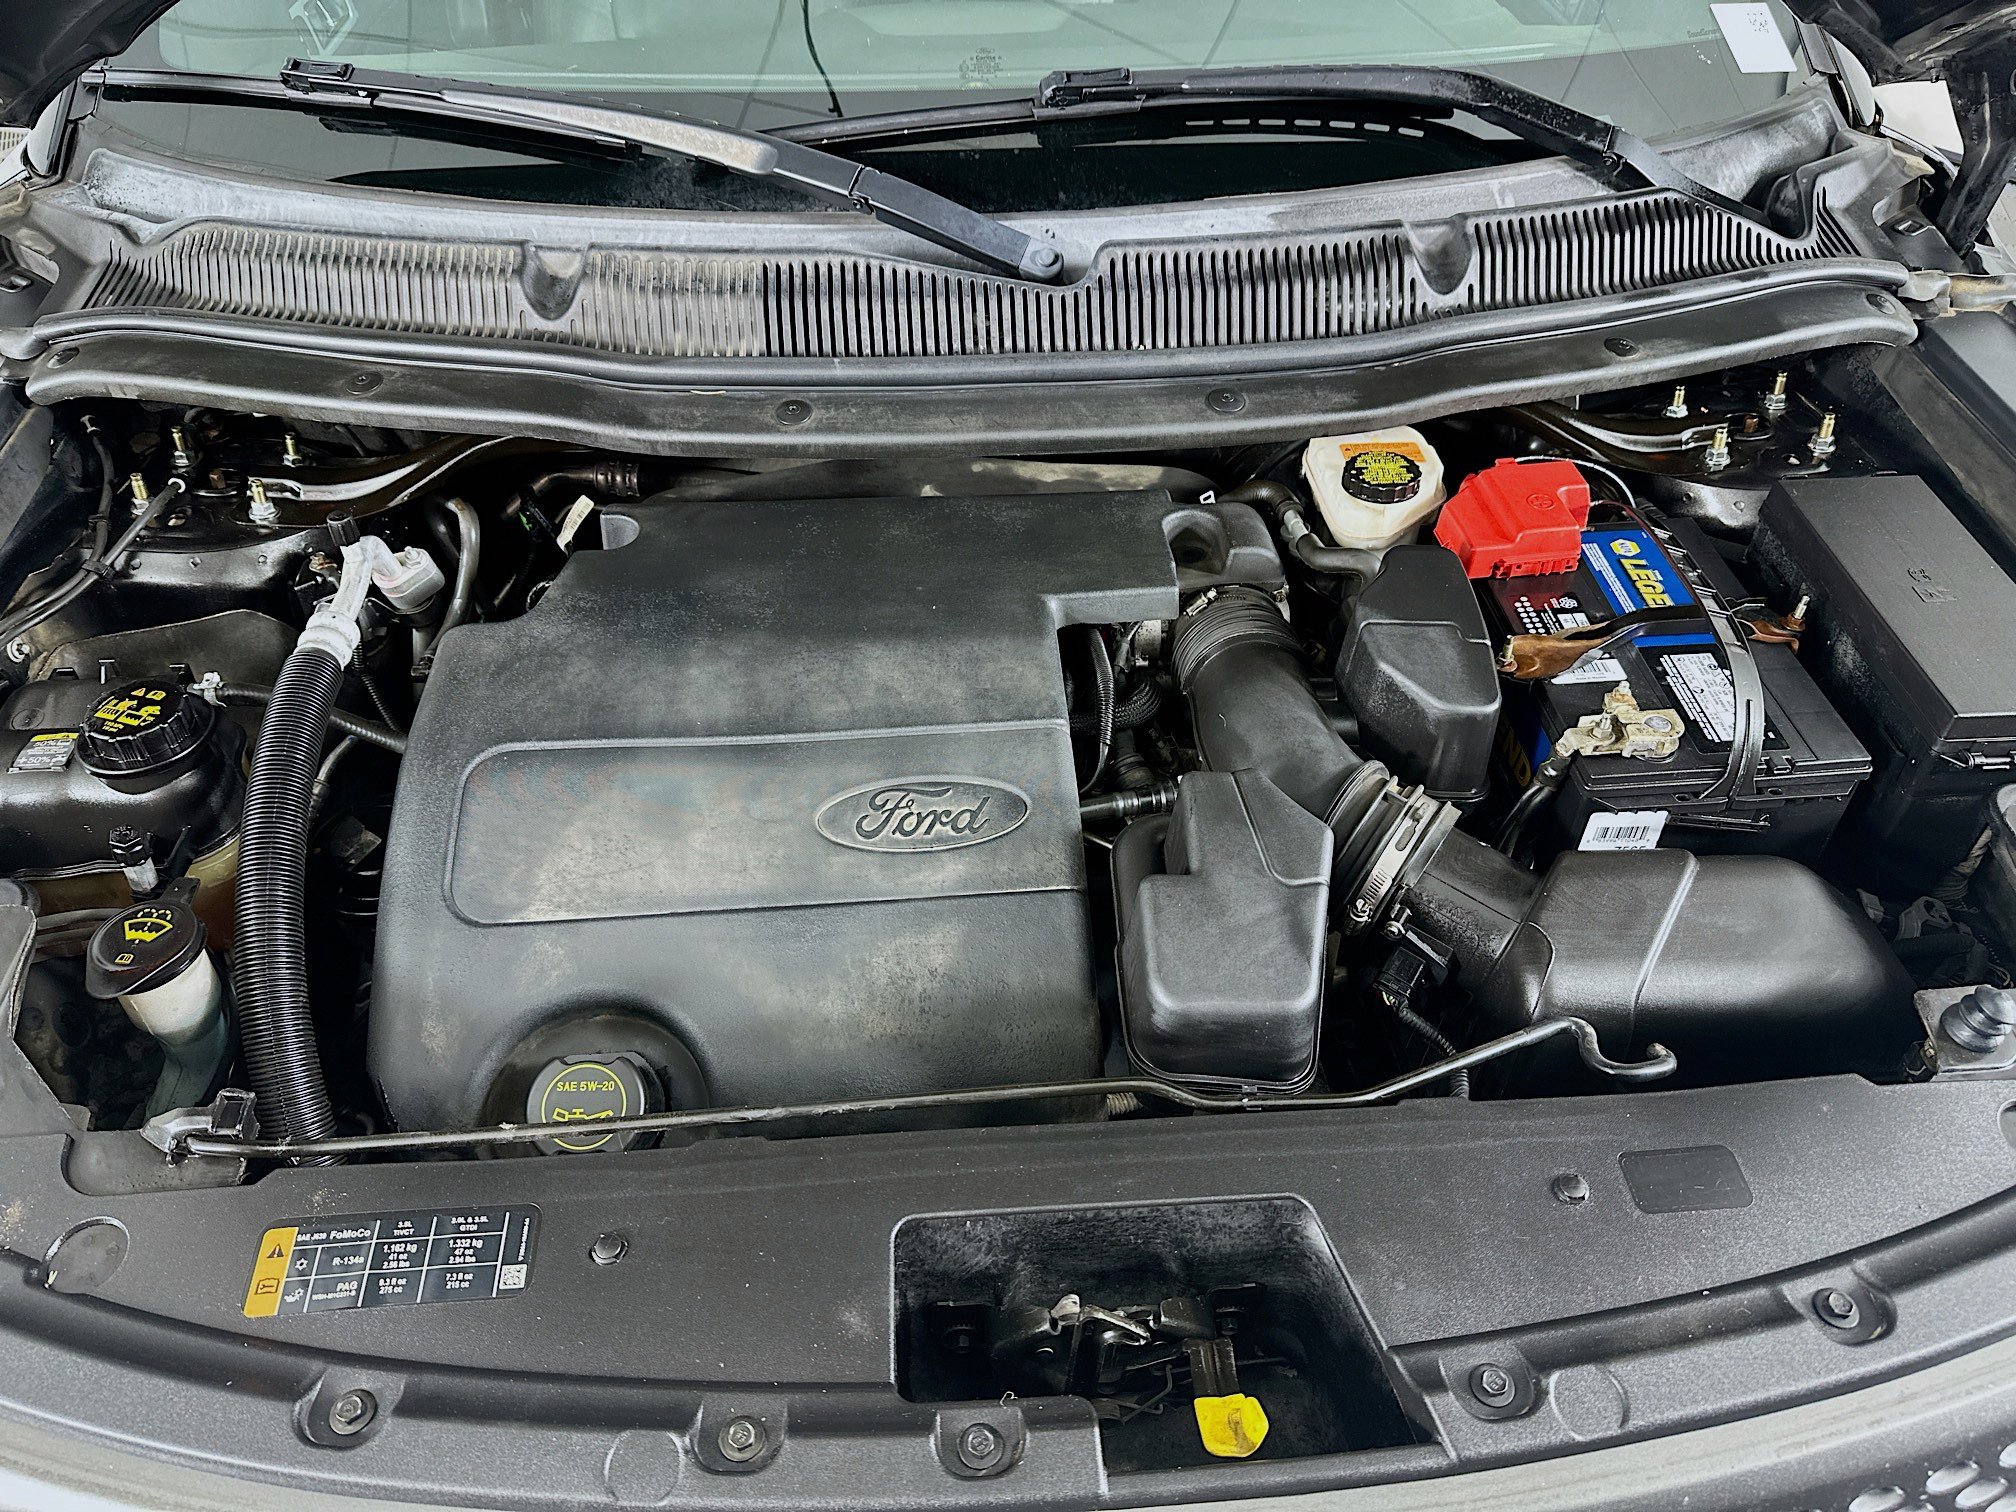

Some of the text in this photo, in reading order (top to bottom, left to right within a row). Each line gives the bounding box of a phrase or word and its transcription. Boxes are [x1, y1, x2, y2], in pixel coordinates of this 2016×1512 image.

[1620, 559, 1675, 608] LEGE
[855, 789, 991, 840] Ford
[556, 1080, 615, 1092] SAE 5W-20
[297, 1233, 311, 1241] SAE
[329, 1228, 371, 1240] FoMoCo
[383, 1243, 418, 1253] 1.162 kg
[448, 1238, 483, 1248] 1.332 kg
[332, 1255, 365, 1266] R-134a
[398, 1260, 410, 1268] lbs
[464, 1255, 476, 1263] lbs
[464, 1272, 474, 1280] oz
[336, 1281, 358, 1291] PAG
[446, 1280, 460, 1289] 215
[378, 1286, 392, 1294] 275
